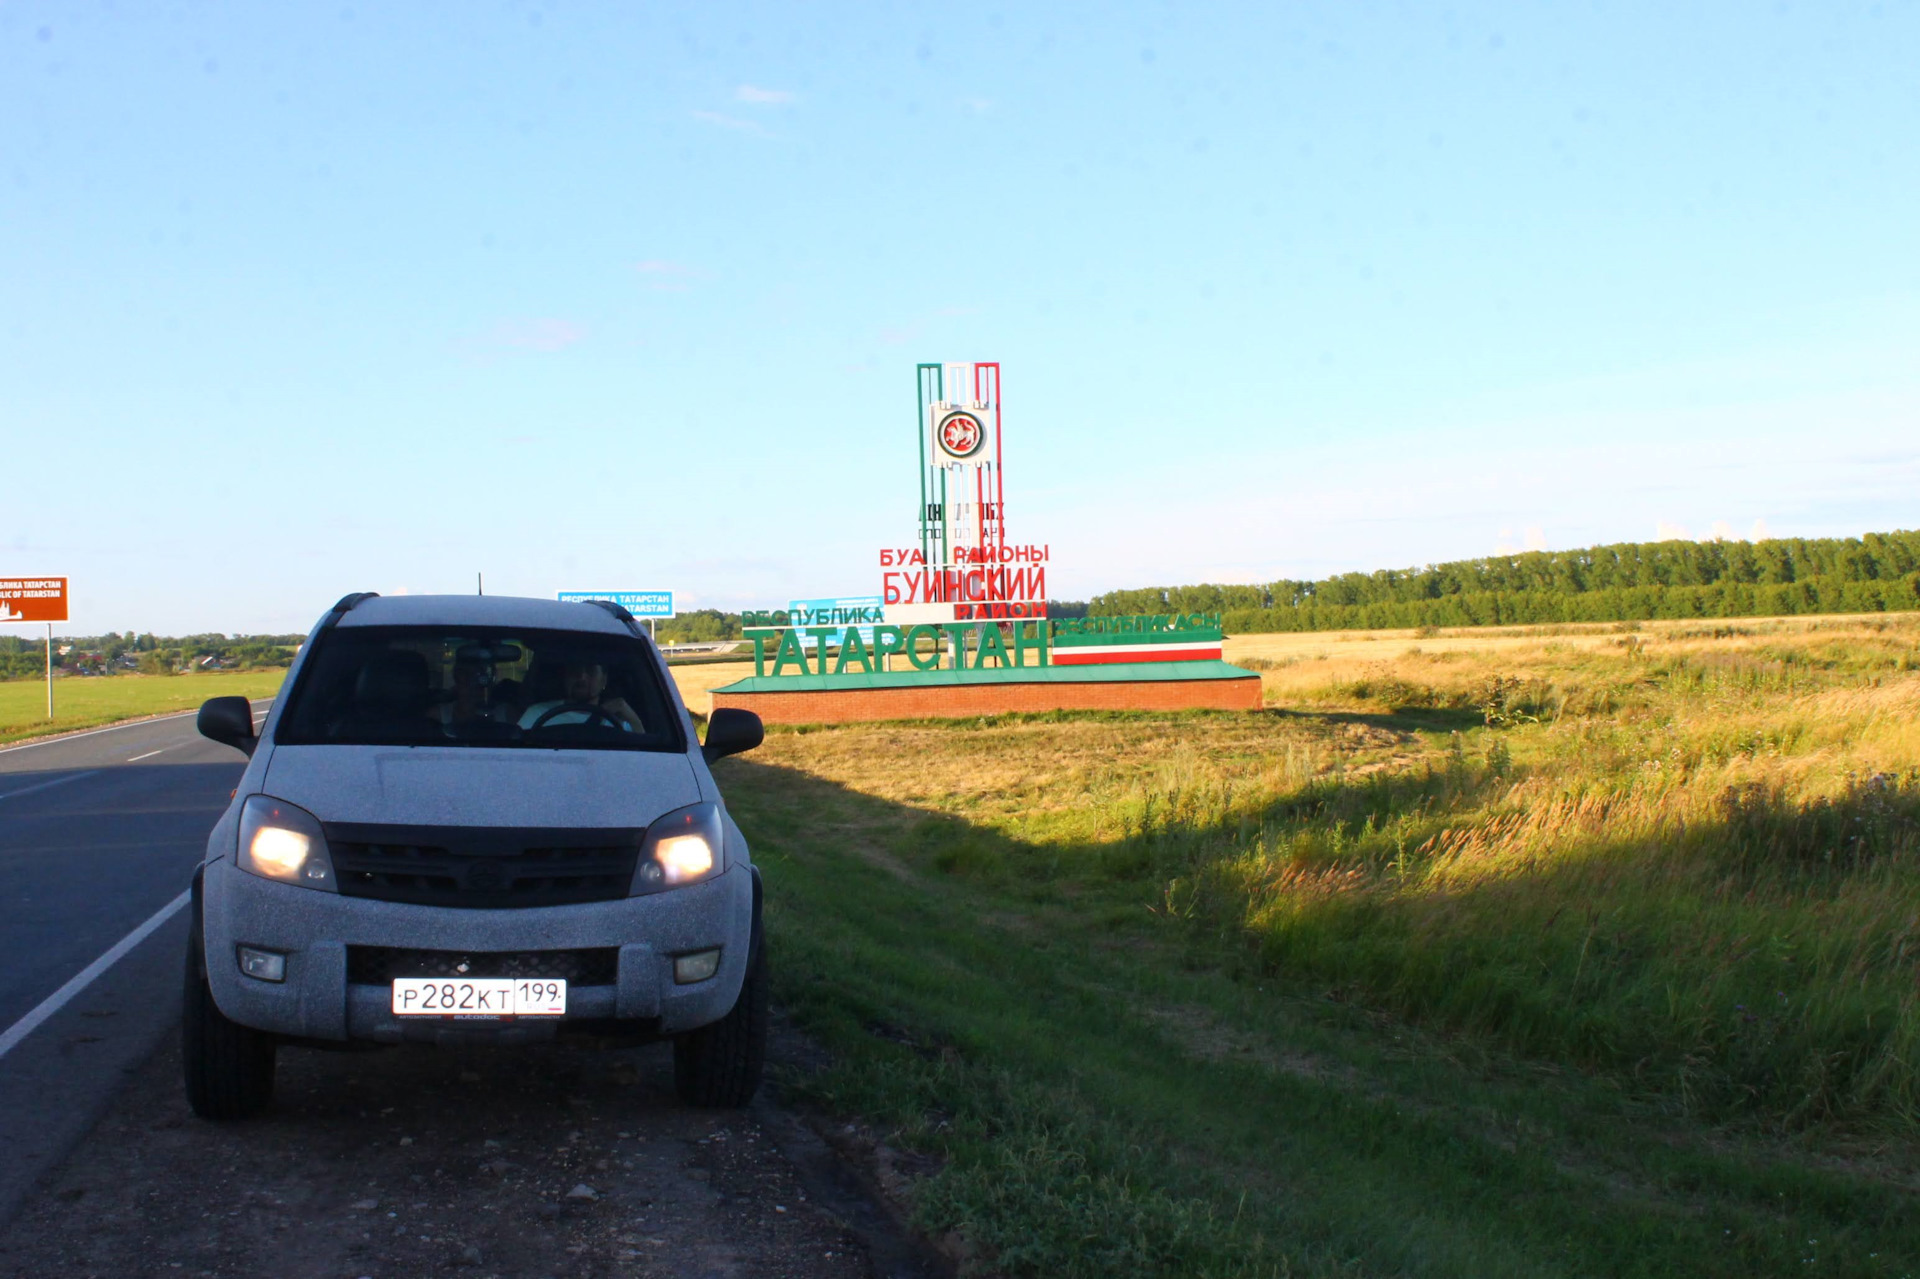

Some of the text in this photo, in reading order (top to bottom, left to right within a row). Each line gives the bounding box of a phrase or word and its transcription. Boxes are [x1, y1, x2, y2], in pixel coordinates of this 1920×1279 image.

[880, 543, 1049, 566] БУА РАЙОНЫ
[23, 580, 62, 589] ТАТАРСТАН
[23, 589, 61, 598] TATARSTAN
[883, 563, 1046, 605] БУИНСКИЙ
[620, 595, 669, 603] ТАТАРСТАН
[621, 604, 669, 612] ATARSTAN
[742, 606, 885, 627] РЕСПУБЛИКА
[1052, 612, 1222, 635] РЕСПУБЛИКАСЫ
[743, 620, 1048, 677] ТАТАРСТАН
[519, 982, 558, 1002] 199
